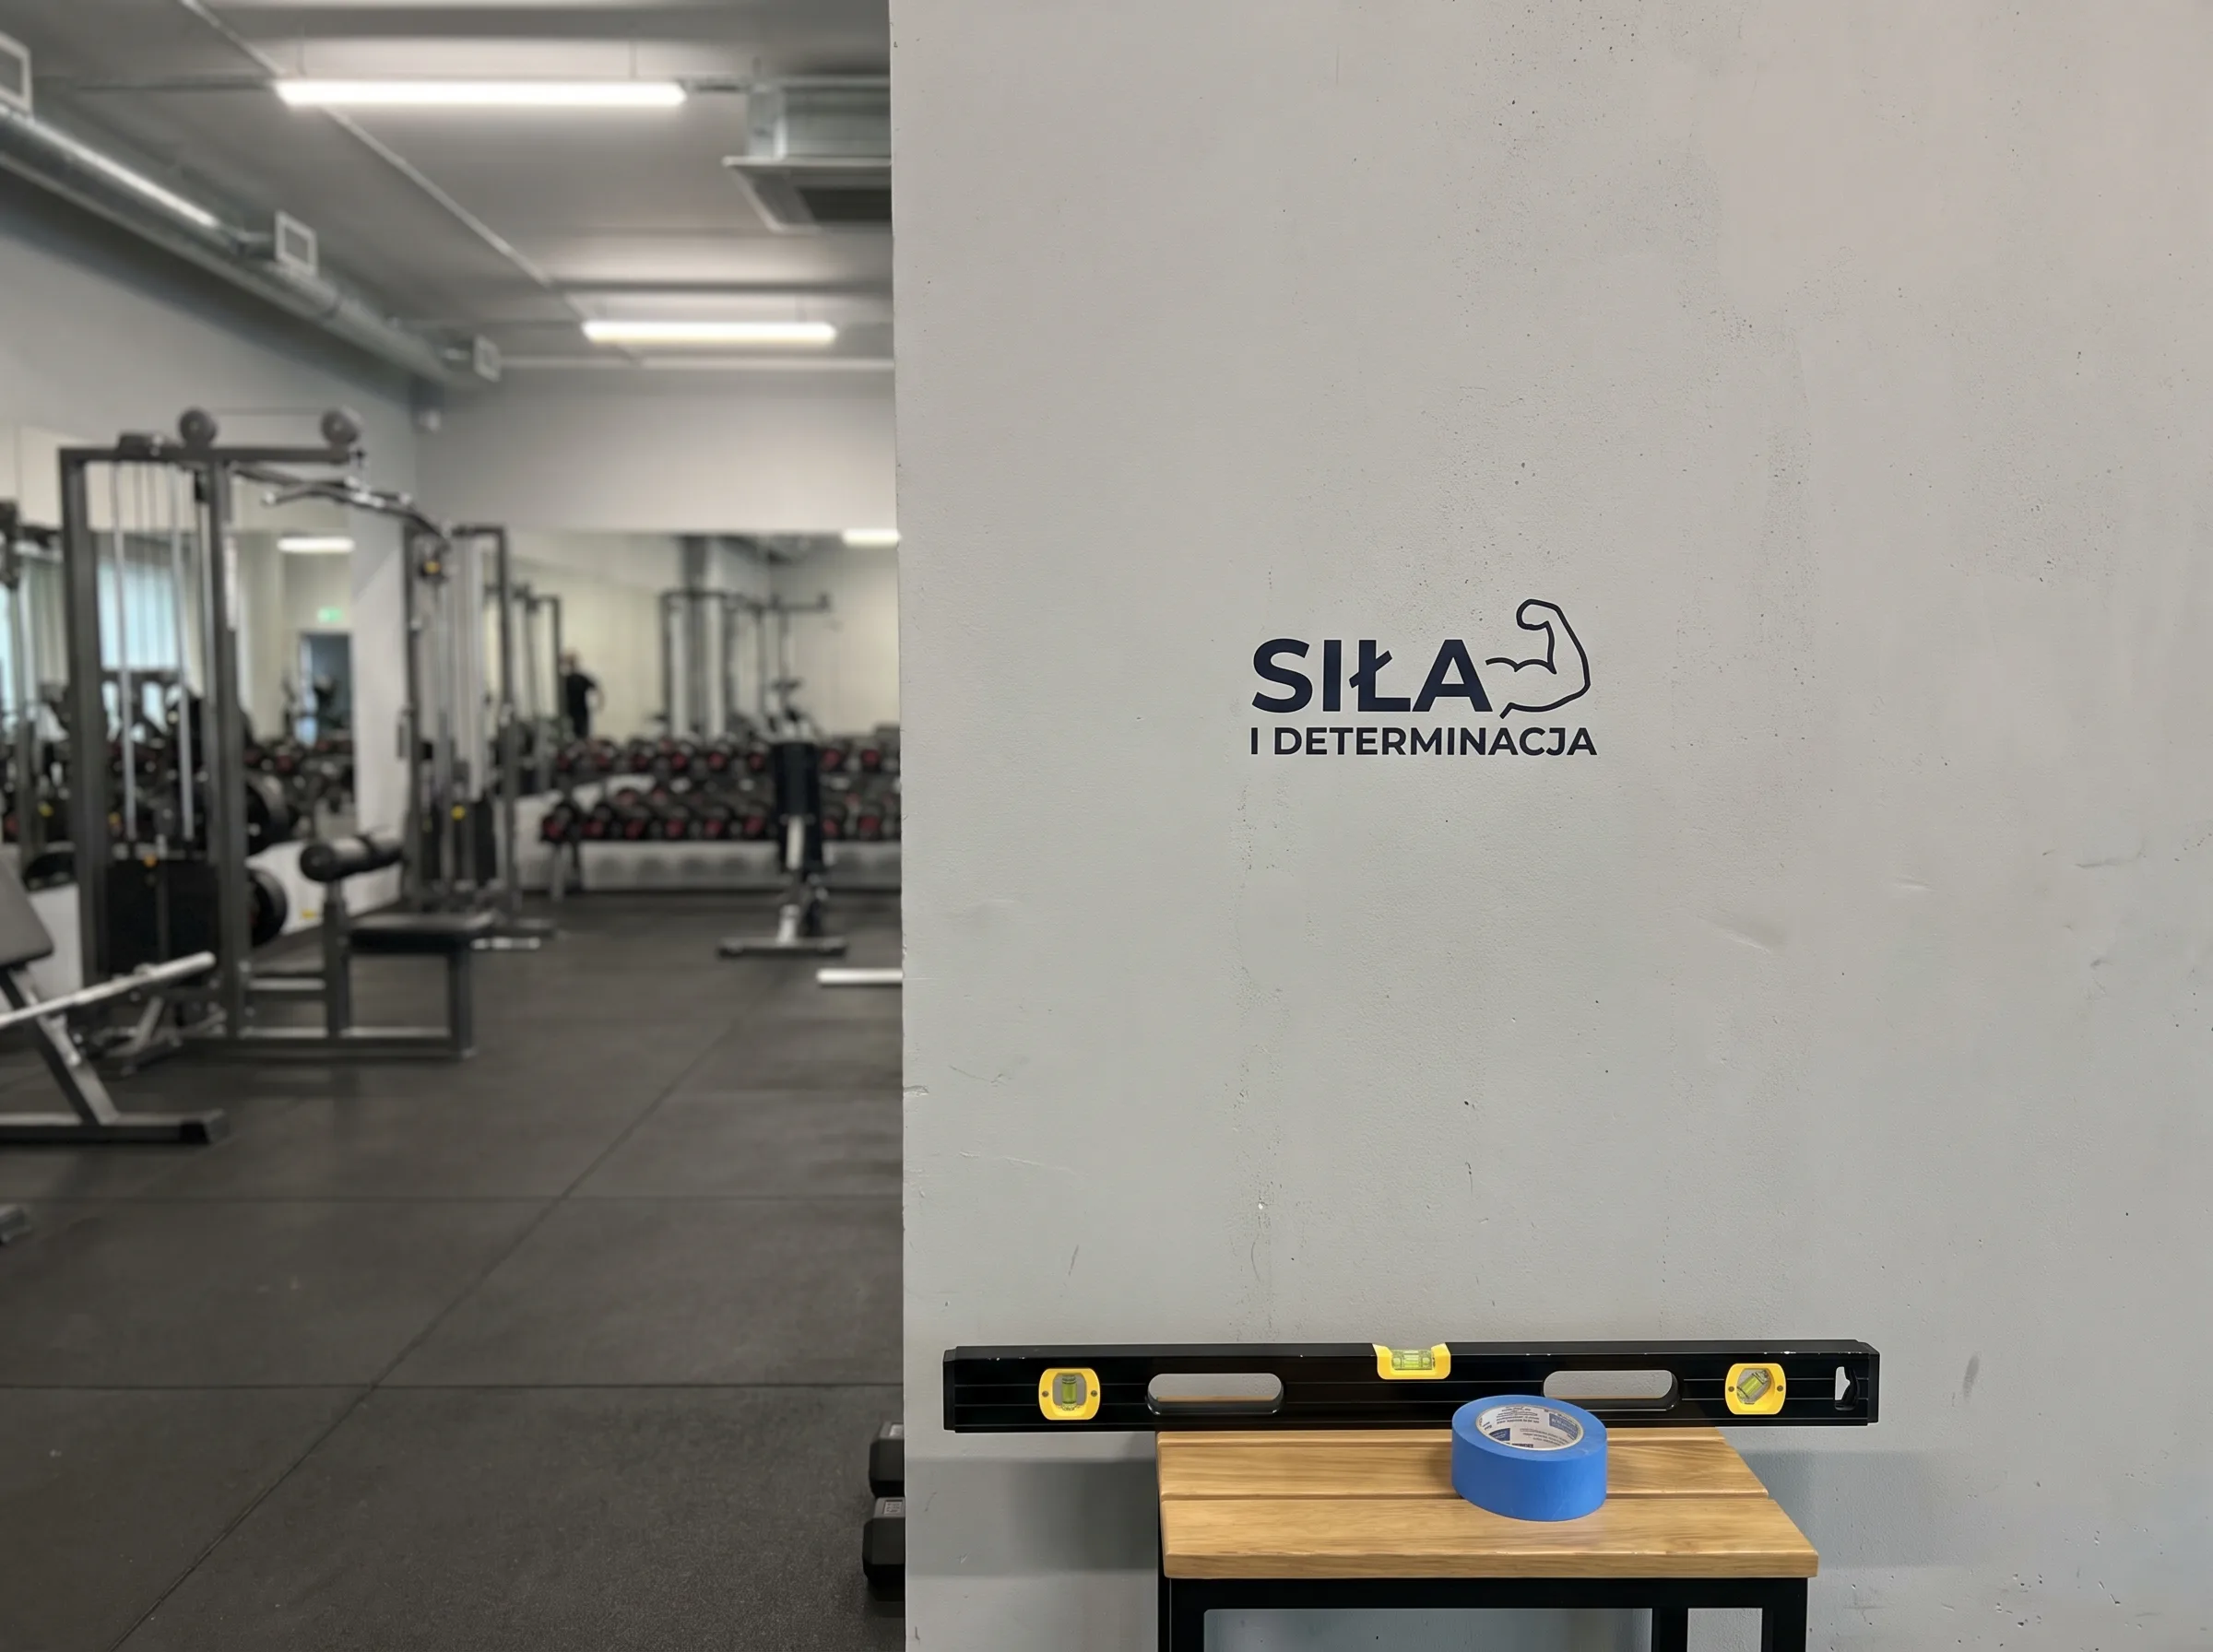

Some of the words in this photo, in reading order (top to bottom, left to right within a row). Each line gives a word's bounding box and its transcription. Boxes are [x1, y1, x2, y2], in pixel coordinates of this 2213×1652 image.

[1251, 638, 1493, 713] SIŁA
[1250, 726, 1259, 755] I
[1273, 726, 1598, 756] DETERMINACJA
